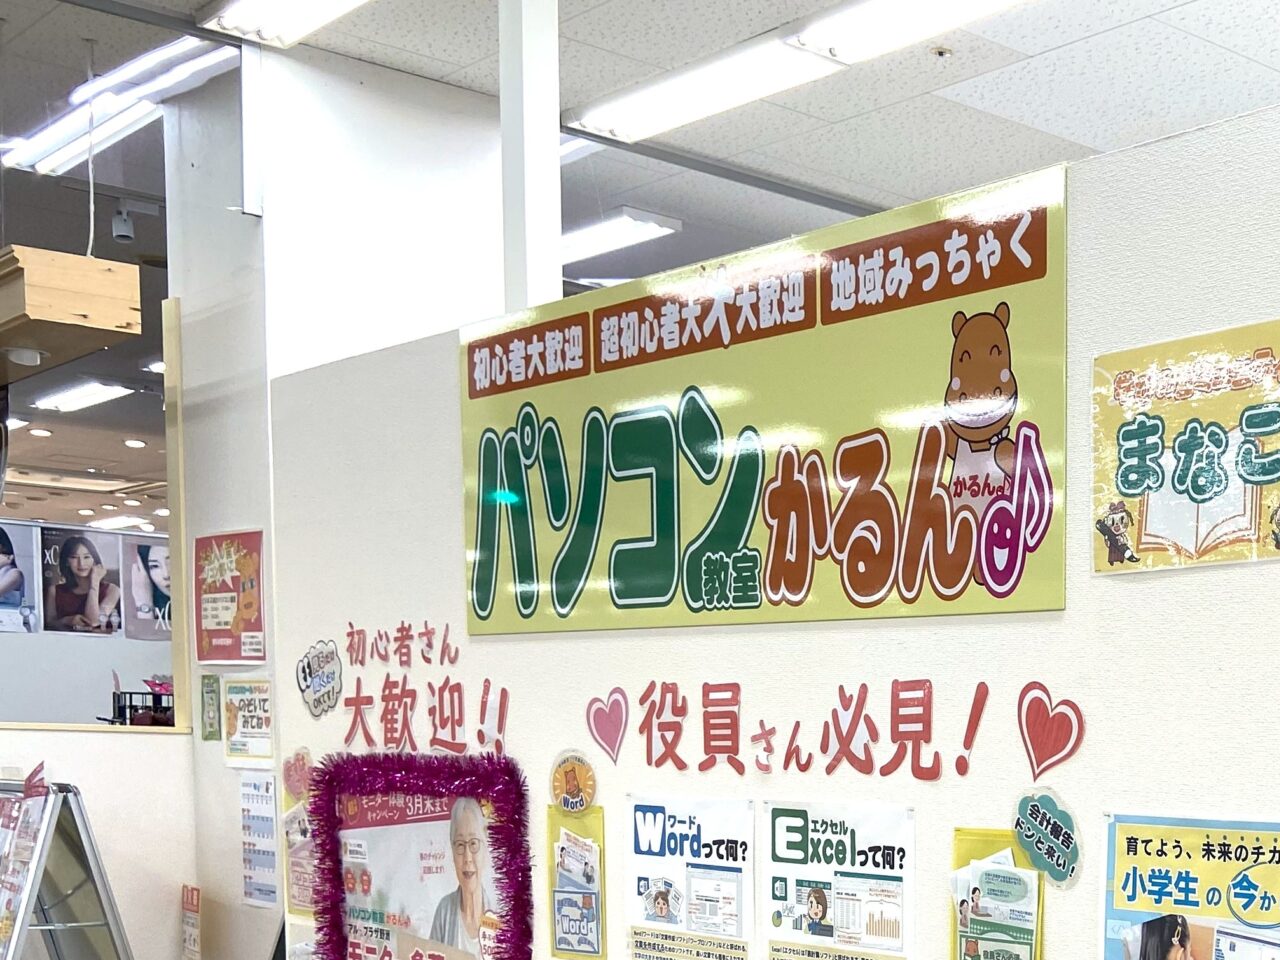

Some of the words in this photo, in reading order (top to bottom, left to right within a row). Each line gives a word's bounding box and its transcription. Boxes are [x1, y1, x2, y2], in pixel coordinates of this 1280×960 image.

[829, 212, 1034, 311] 地域みっちゃく
[472, 324, 585, 390] 初心者大歓迎
[473, 386, 765, 620] パソコン
[701, 549, 761, 609] 教室
[346, 620, 460, 667] 初心者さん
[562, 795, 585, 811] Word
[668, 814, 696, 830] ワード
[1028, 803, 1075, 851] 会計報告
[811, 819, 848, 836] エクセル
